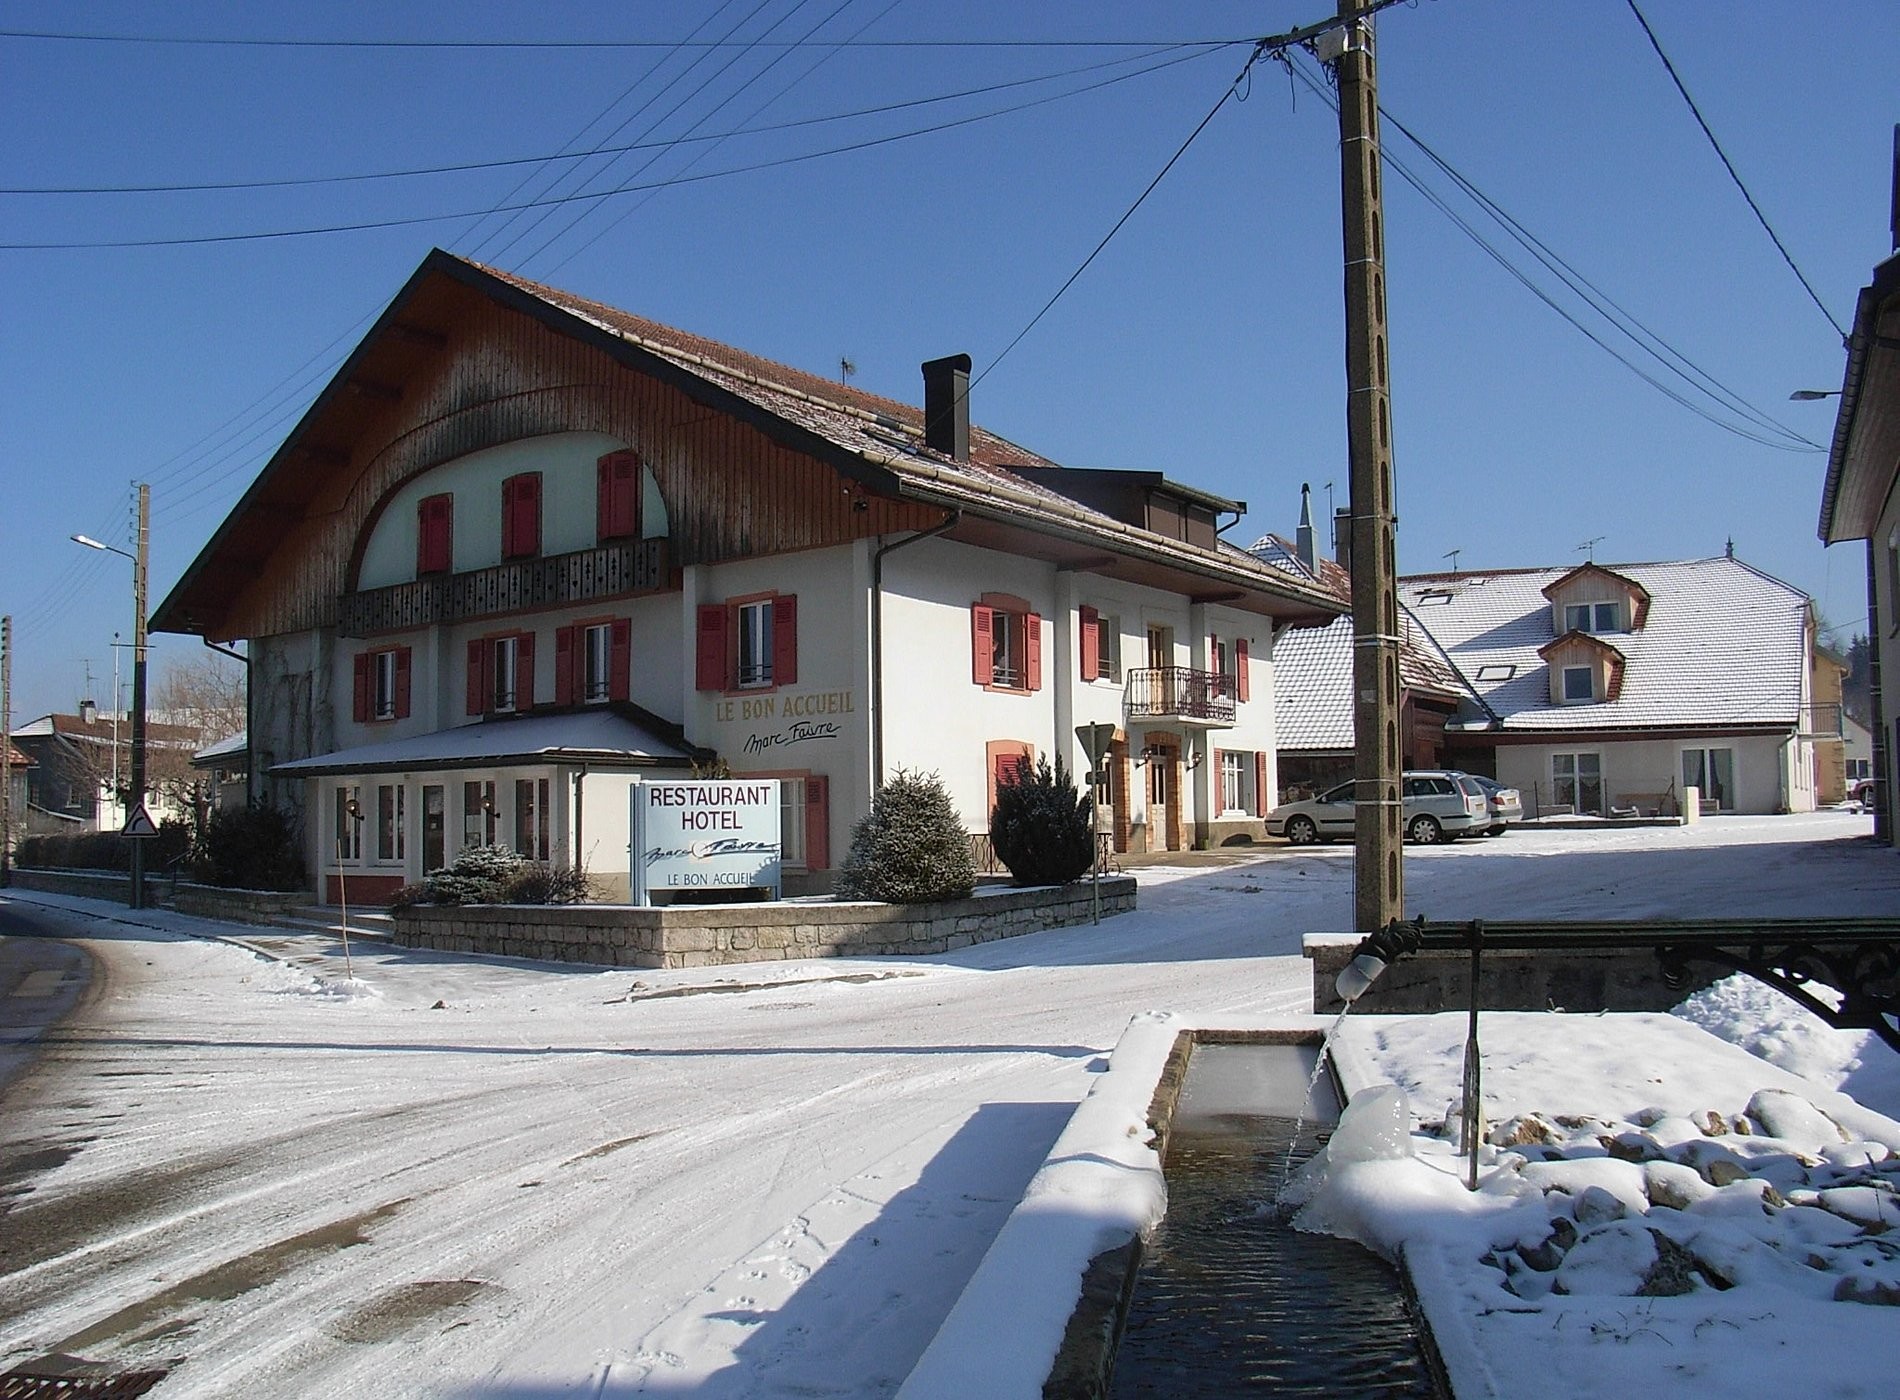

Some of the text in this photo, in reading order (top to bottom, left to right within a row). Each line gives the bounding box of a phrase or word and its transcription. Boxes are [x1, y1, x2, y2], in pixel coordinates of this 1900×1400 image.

[716, 691, 855, 721] LE BON ACCUEIL
[743, 721, 842, 756] Marc Faivre
[650, 786, 771, 806] RESTAURANT
[682, 811, 743, 830] HOTEL
[667, 872, 755, 886] LE BON ACCUEIL
